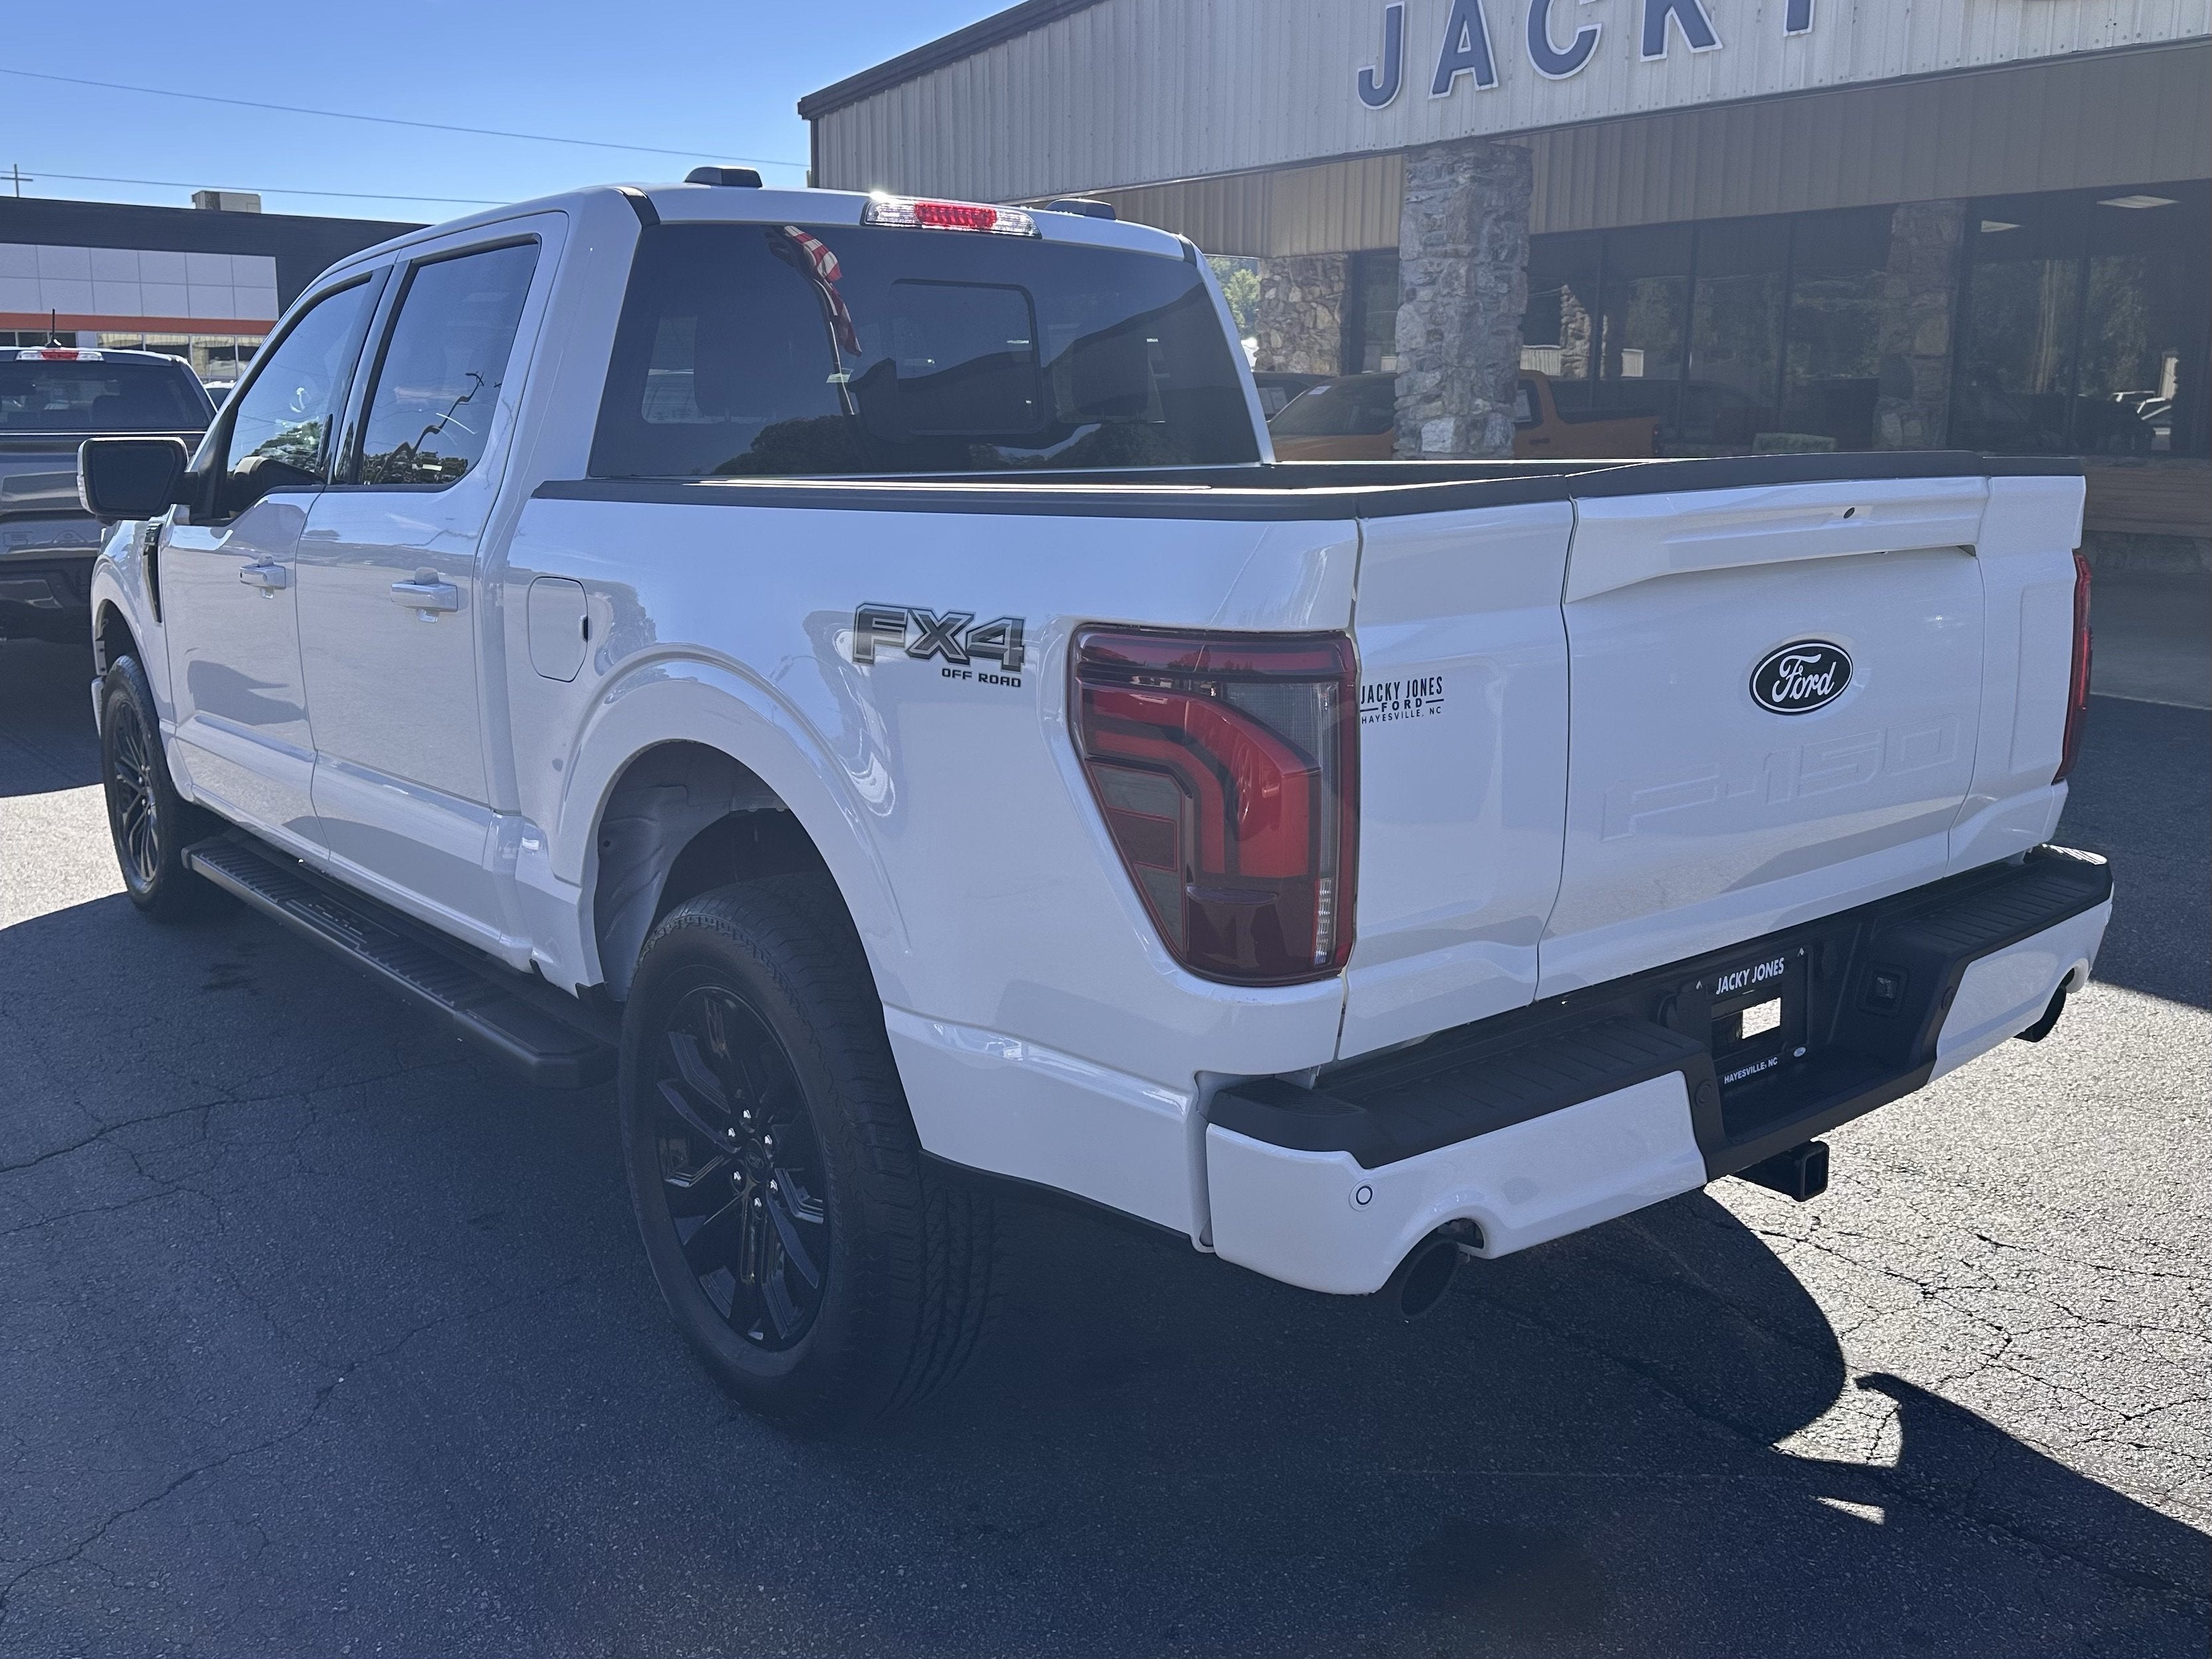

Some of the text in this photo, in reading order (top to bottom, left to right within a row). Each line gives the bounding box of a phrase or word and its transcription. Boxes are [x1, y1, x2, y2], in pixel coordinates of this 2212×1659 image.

[853, 601, 1026, 674] FX4
[942, 668, 1021, 687] OFF ROAD
[1361, 676, 1442, 705] JACKY JONES
[1772, 654, 1836, 703] Ford
[1361, 706, 1442, 725] HAYESVILLE, NC
[1381, 697, 1422, 713] FORD
[1601, 713, 1960, 842] F-150
[1715, 957, 1784, 995] JACKY JONES
[1724, 1057, 1778, 1085] HAYESVILLE, NC
